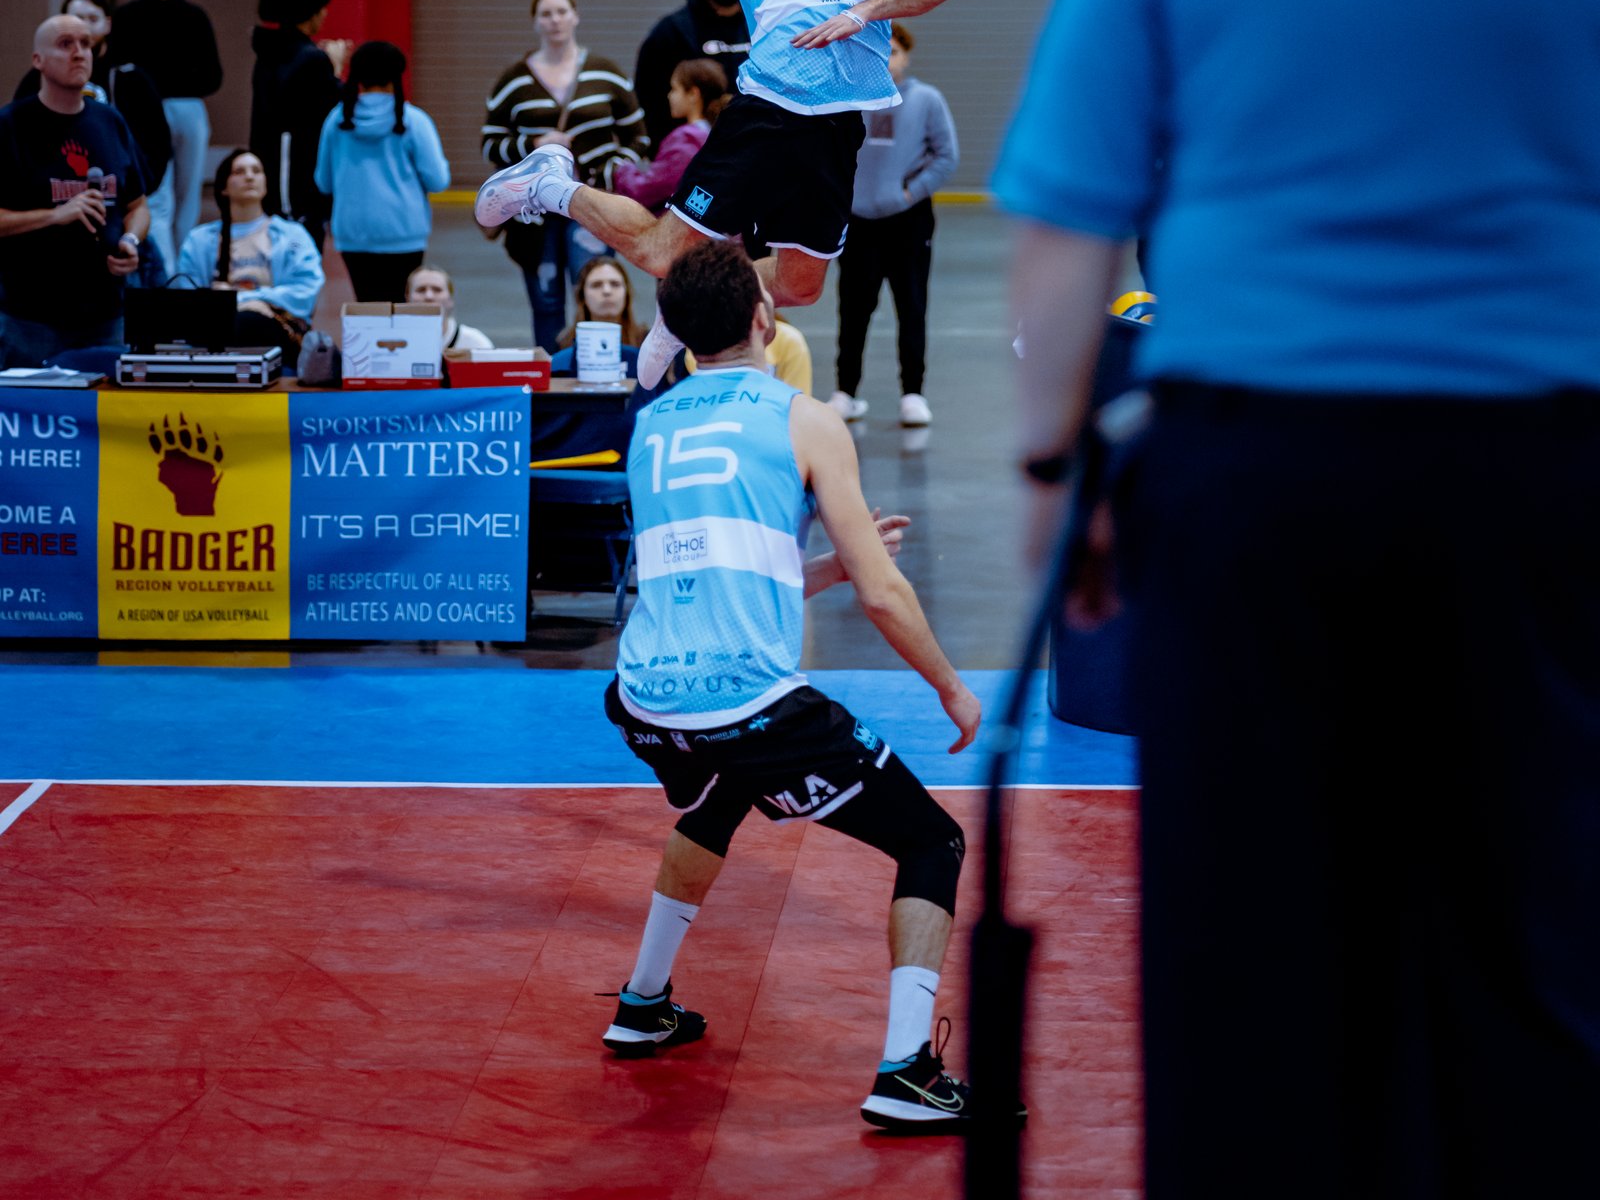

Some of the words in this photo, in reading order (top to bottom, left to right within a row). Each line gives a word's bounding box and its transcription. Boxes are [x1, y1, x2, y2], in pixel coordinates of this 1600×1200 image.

[650, 390, 760, 417] ICEMEN
[0, 412, 20, 438] N
[32, 413, 80, 439] US
[302, 410, 523, 437] SPORTSMANSHIP
[10, 448, 81, 468] HERE!
[301, 440, 521, 478] MATTERS!
[645, 421, 743, 493] 15
[0, 504, 52, 525] OME
[59, 506, 76, 525] A
[301, 514, 364, 539] IT'S
[374, 514, 400, 538] A
[410, 512, 520, 538] GAME!
[1, 532, 78, 557] EREE
[112, 521, 276, 572] BADGER
[666, 536, 704, 556] KEHOE
[115, 579, 172, 591] REGION
[177, 580, 275, 593] VOLLEYBALL
[307, 574, 325, 590] BE
[329, 572, 420, 590] RESPECTFUL
[423, 572, 444, 590] OF
[448, 573, 474, 590] ALL
[0, 587, 14, 602] P
[19, 587, 46, 603] AT:
[0, 611, 84, 621] LLEYBALL.ORG
[117, 609, 125, 621] A
[127, 609, 164, 621] REGION
[167, 609, 179, 621] OF
[183, 609, 204, 622] USA
[206, 608, 270, 621] VOLLEYBALL
[305, 602, 389, 622] ATHLETES
[393, 602, 433, 623] AND
[436, 602, 516, 624] COACHES
[640, 676, 743, 697] NOVUS
